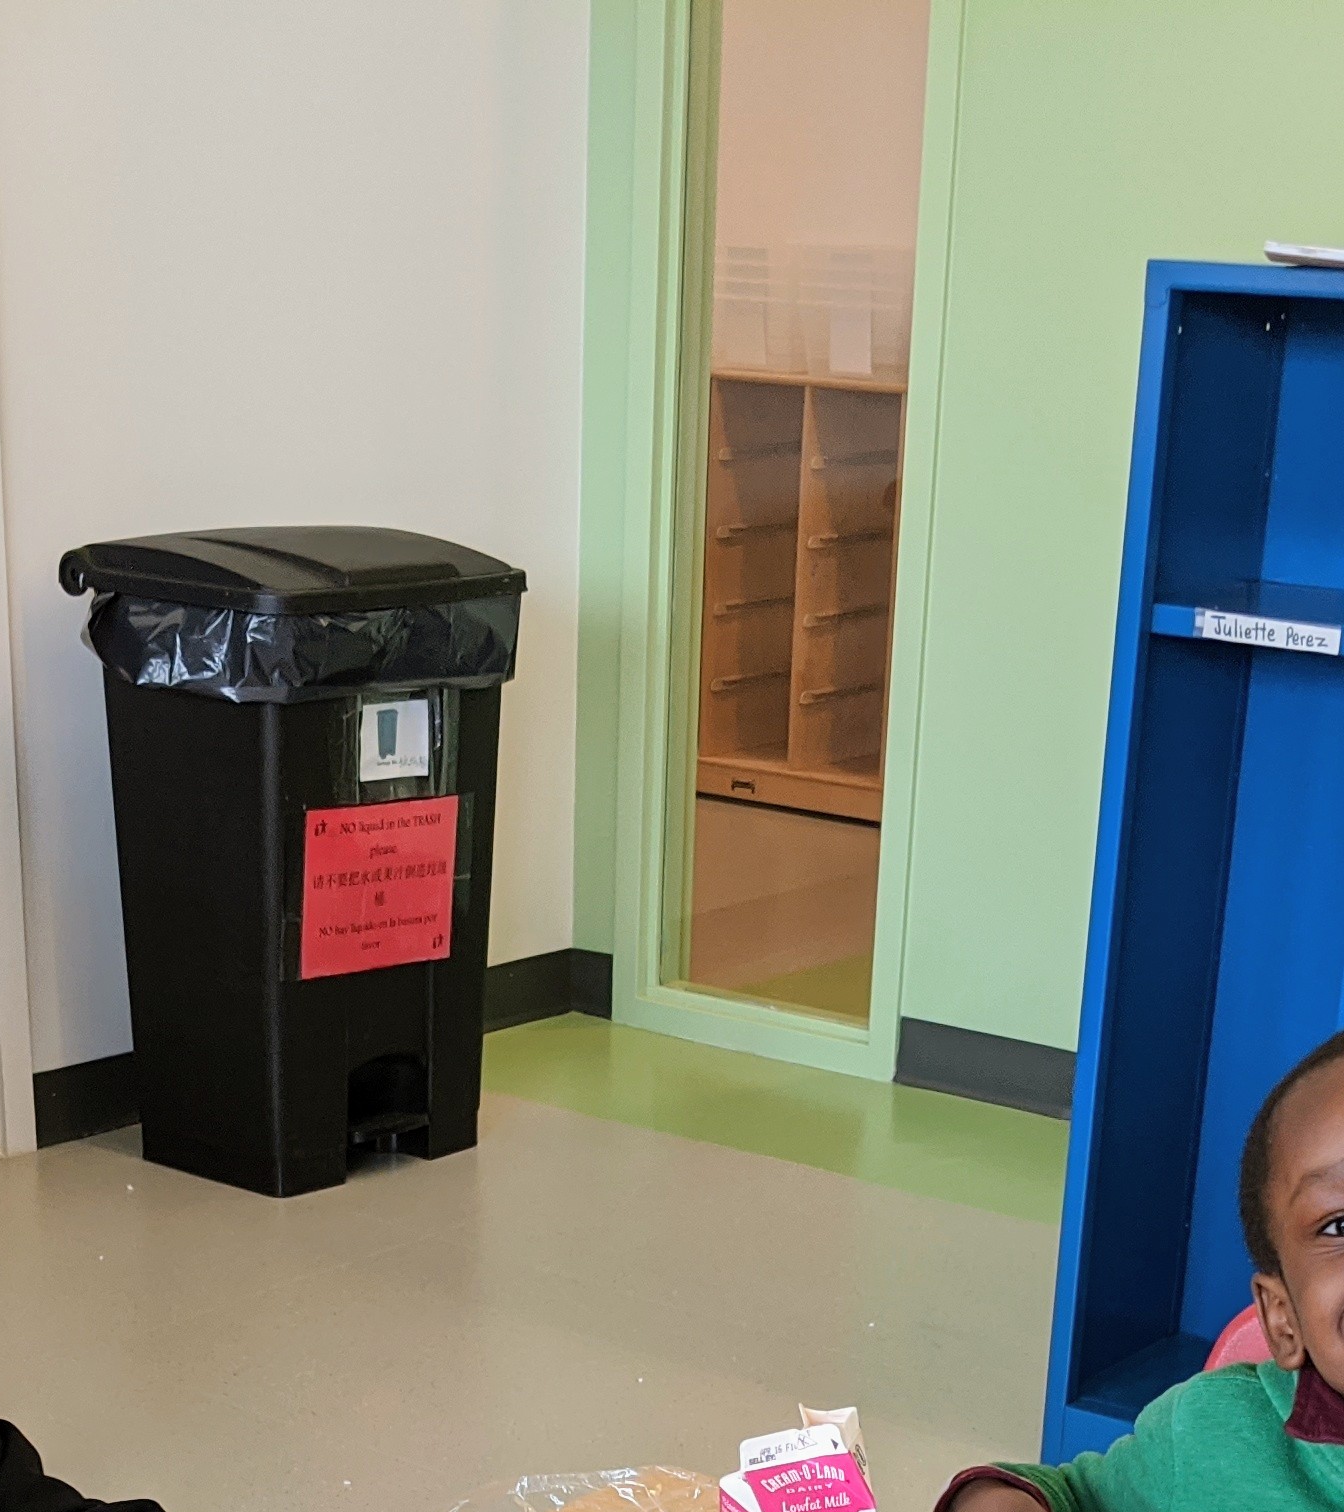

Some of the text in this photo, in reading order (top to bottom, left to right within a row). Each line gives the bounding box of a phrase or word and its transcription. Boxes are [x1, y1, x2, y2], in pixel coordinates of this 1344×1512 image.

[1210, 615, 1329, 648] Juliette Perez
[339, 821, 356, 835] NO
[413, 813, 442, 827] TRASH
[785, 1482, 834, 1494] DAIRY
[824, 1491, 852, 1509] Milk
